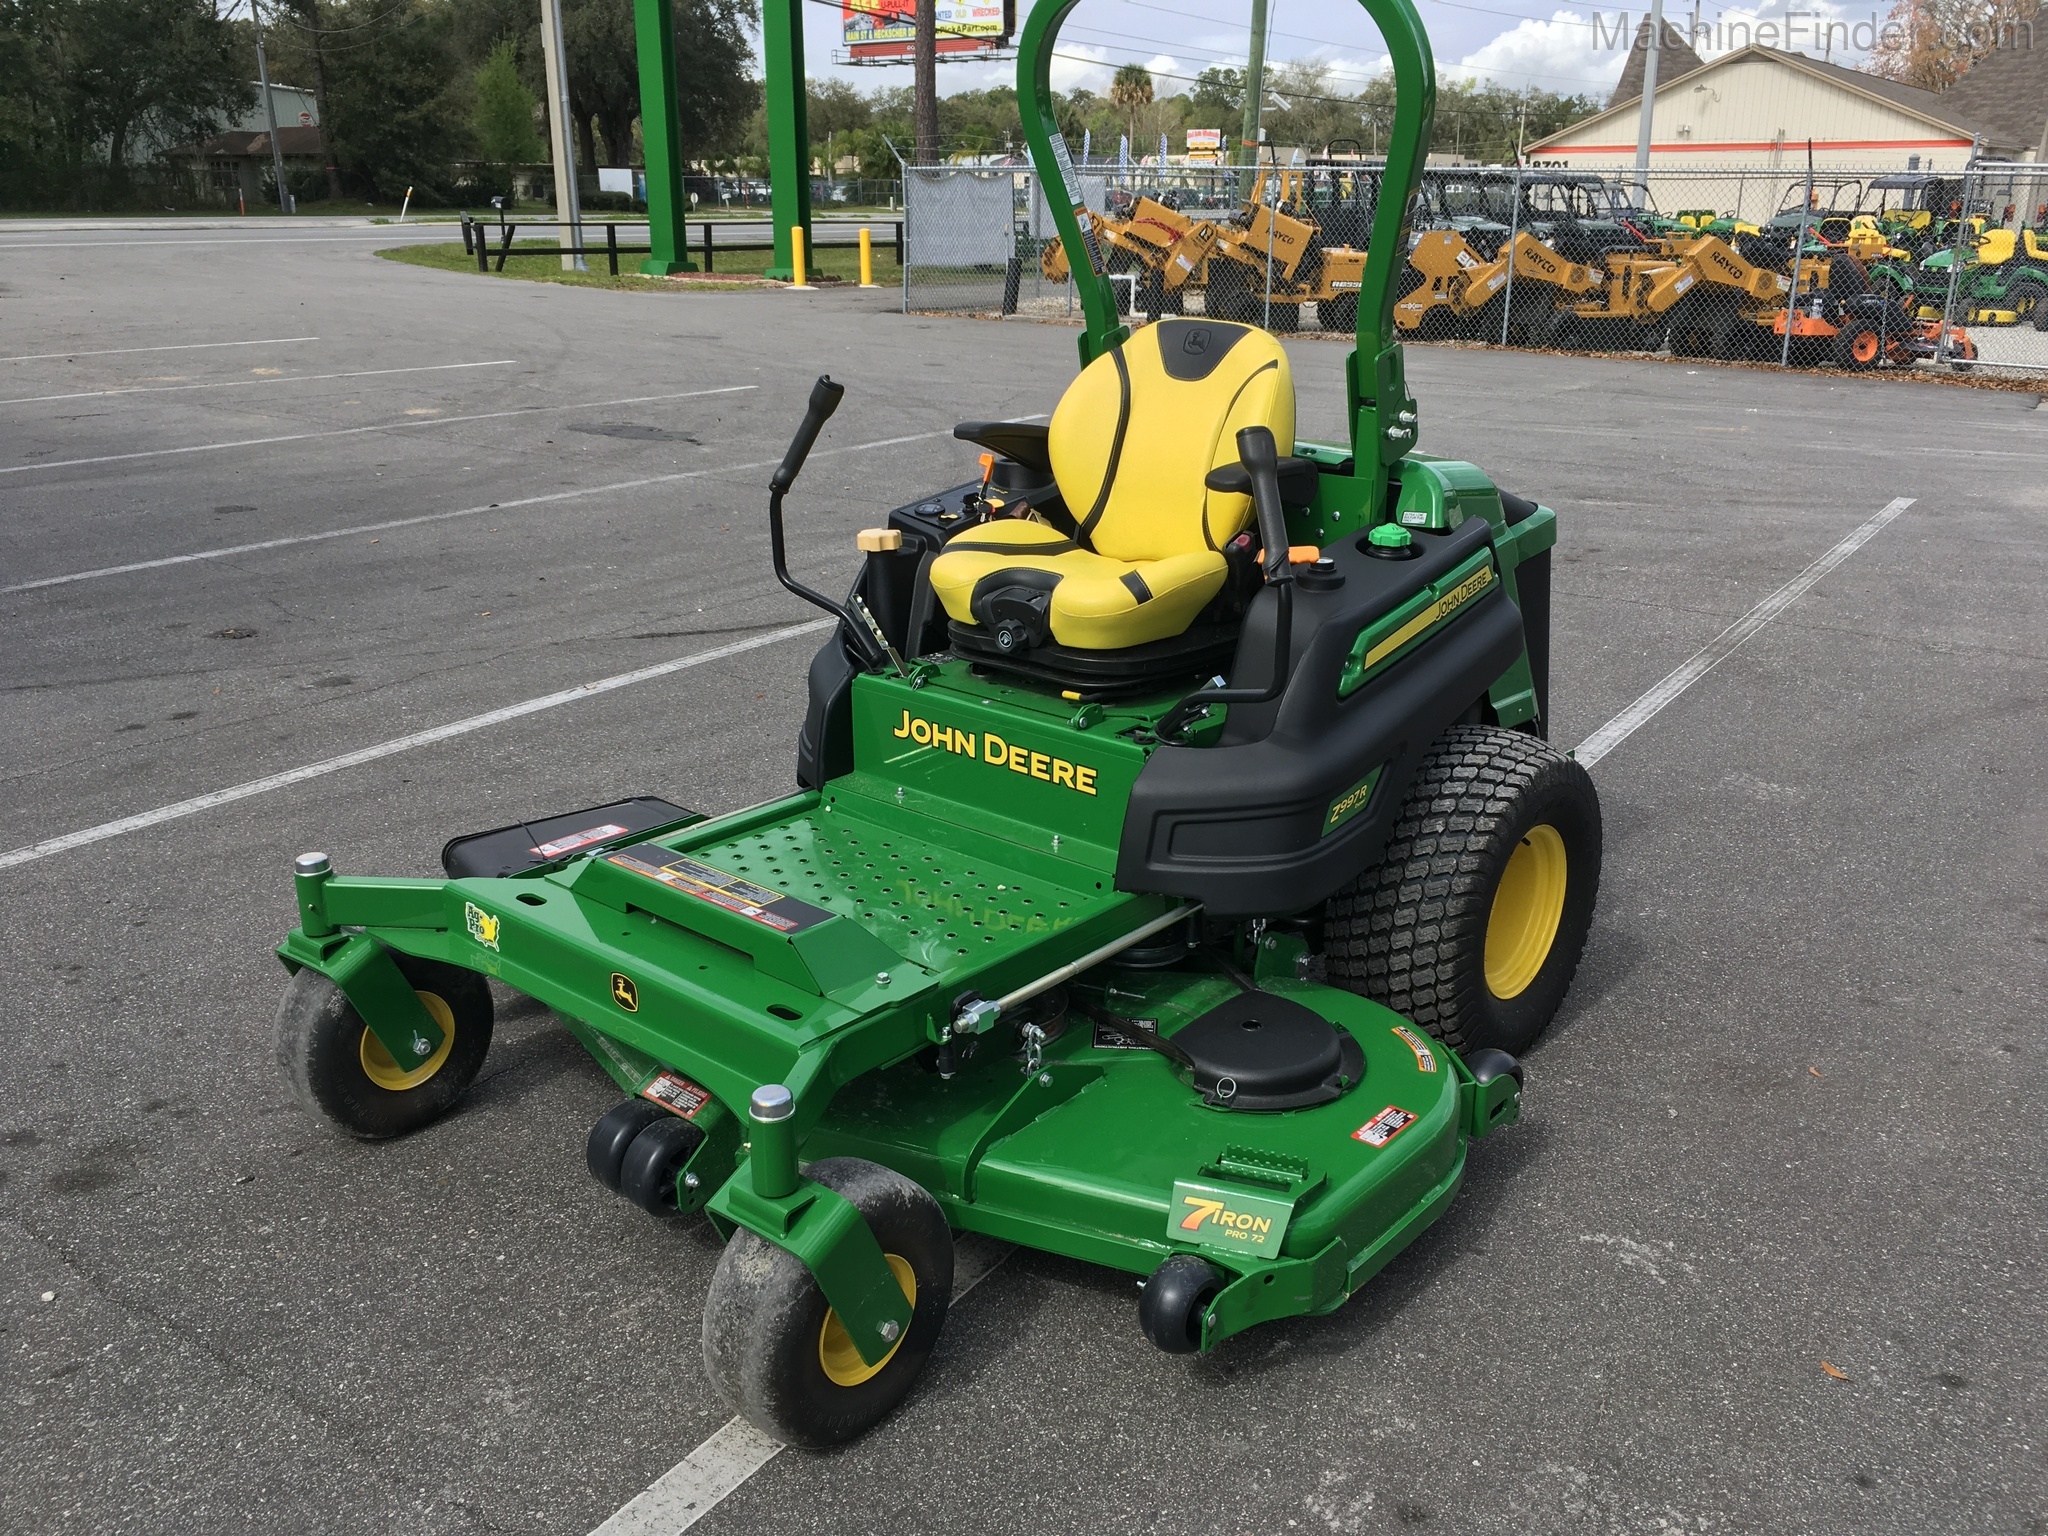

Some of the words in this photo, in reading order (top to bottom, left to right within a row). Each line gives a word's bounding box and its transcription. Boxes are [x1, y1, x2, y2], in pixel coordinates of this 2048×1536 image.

[972, 7, 1000, 17] WRECKED
[1523, 247, 1557, 274] RAYCO
[1710, 251, 1743, 280] RAYCO
[1436, 592, 1461, 621] JOHN
[1460, 572, 1488, 599] DEERE
[893, 708, 976, 759] JOHN
[983, 731, 1098, 796] DEERE
[1329, 784, 1368, 824] Z997R
[470, 919, 485, 934] Pro
[1224, 1228, 1248, 1241] PRO
[1250, 1233, 1265, 1244] 72
